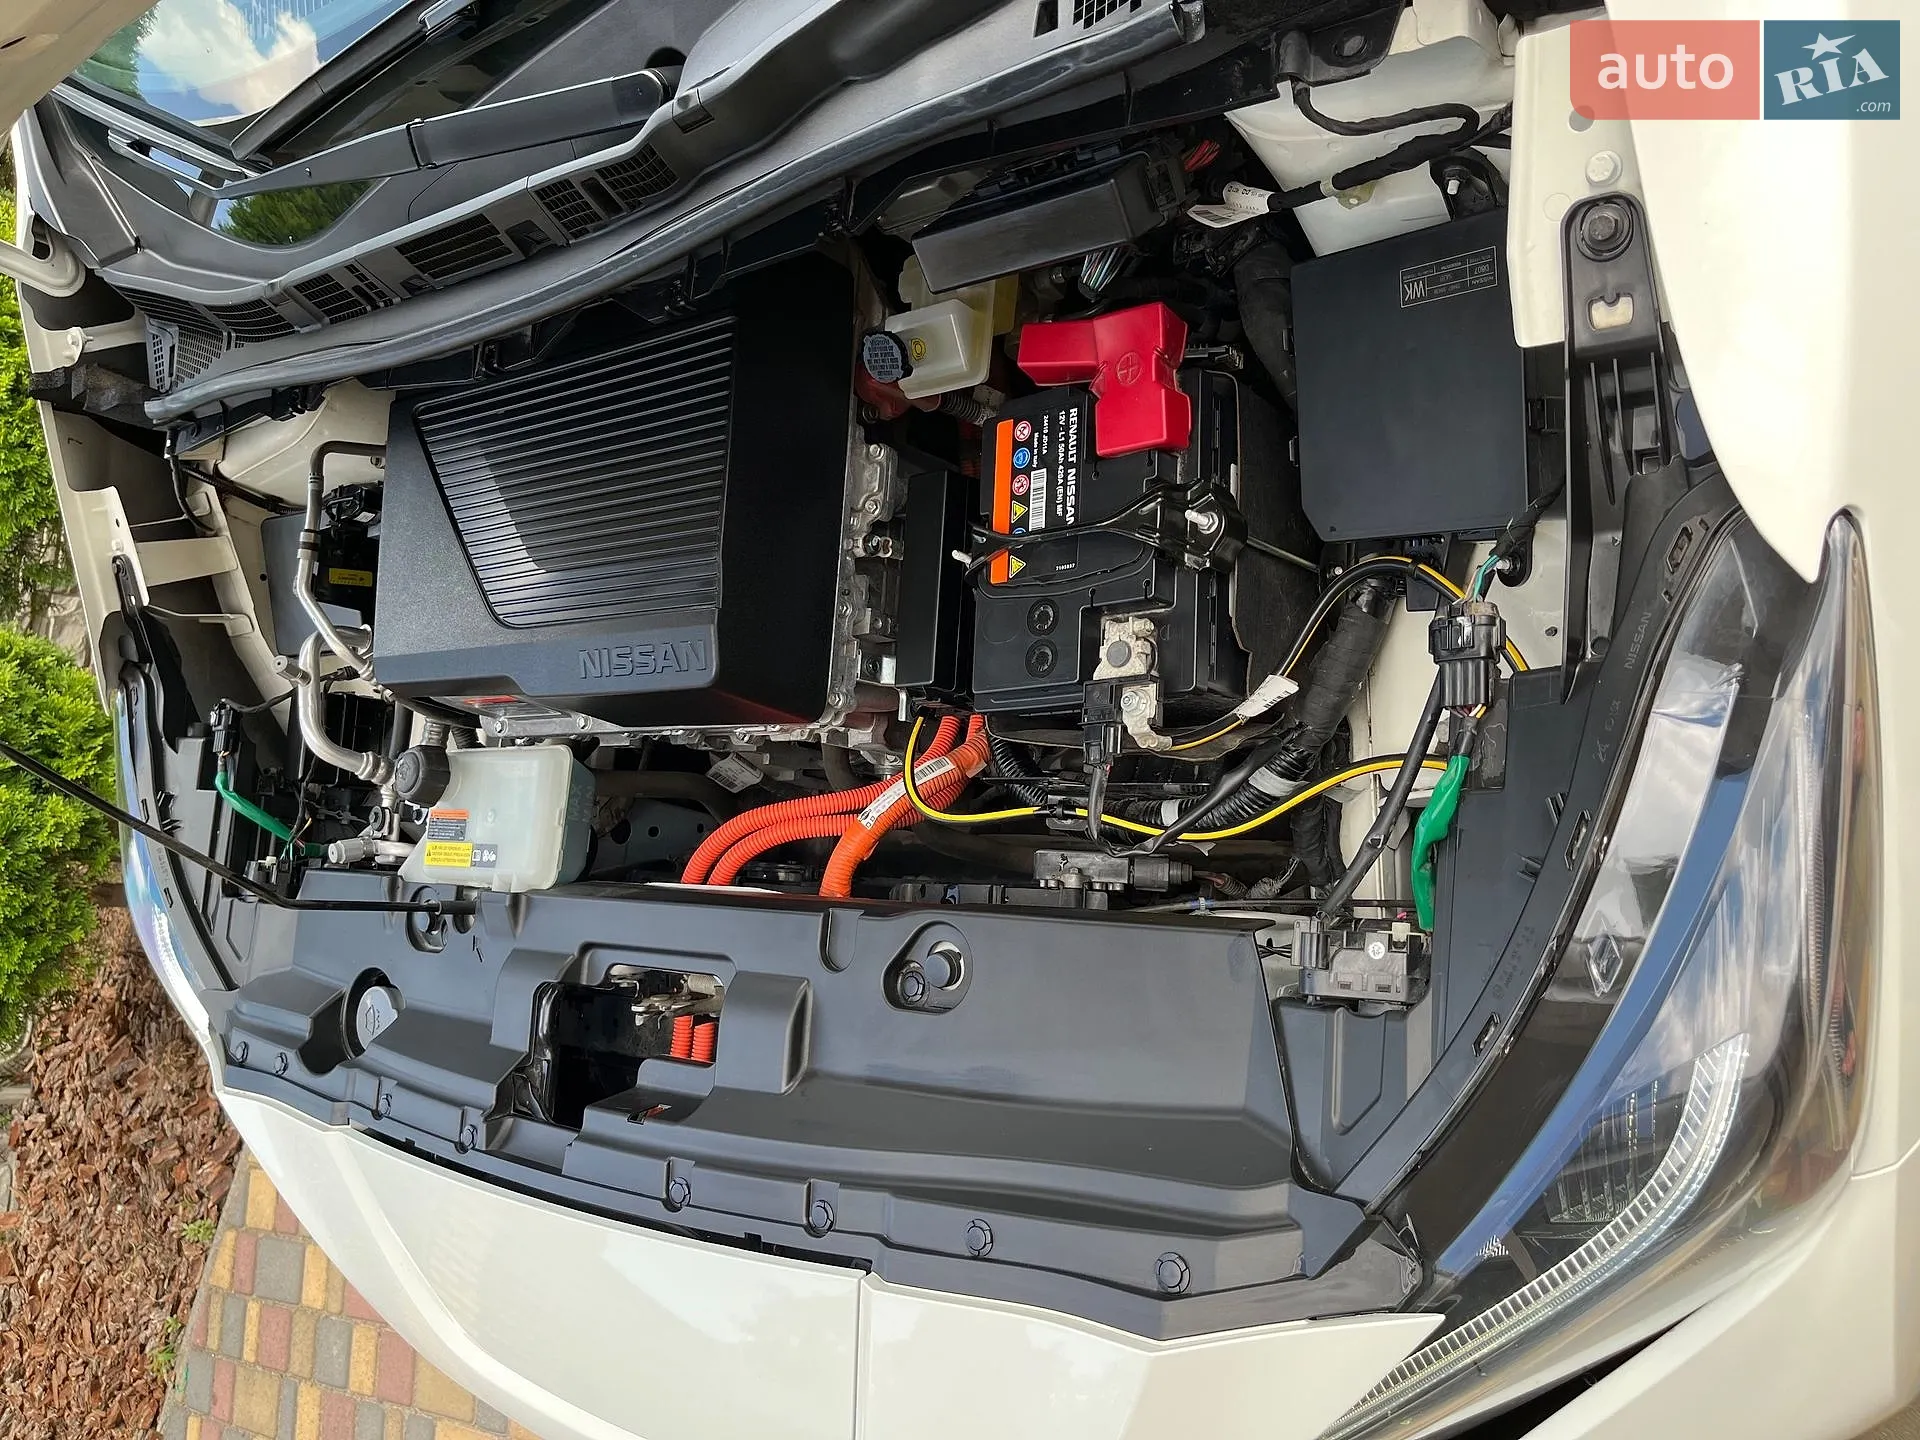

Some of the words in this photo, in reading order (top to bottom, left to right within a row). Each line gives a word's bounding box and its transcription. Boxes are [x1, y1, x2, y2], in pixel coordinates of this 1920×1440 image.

[1404, 280, 1425, 301] WK
[1058, 431, 1065, 441] L1
[1068, 408, 1078, 463] RENAULT
[1057, 504, 1063, 517] MF
[1624, 611, 1652, 669] NISSAN
[578, 640, 707, 679] NISSAN
